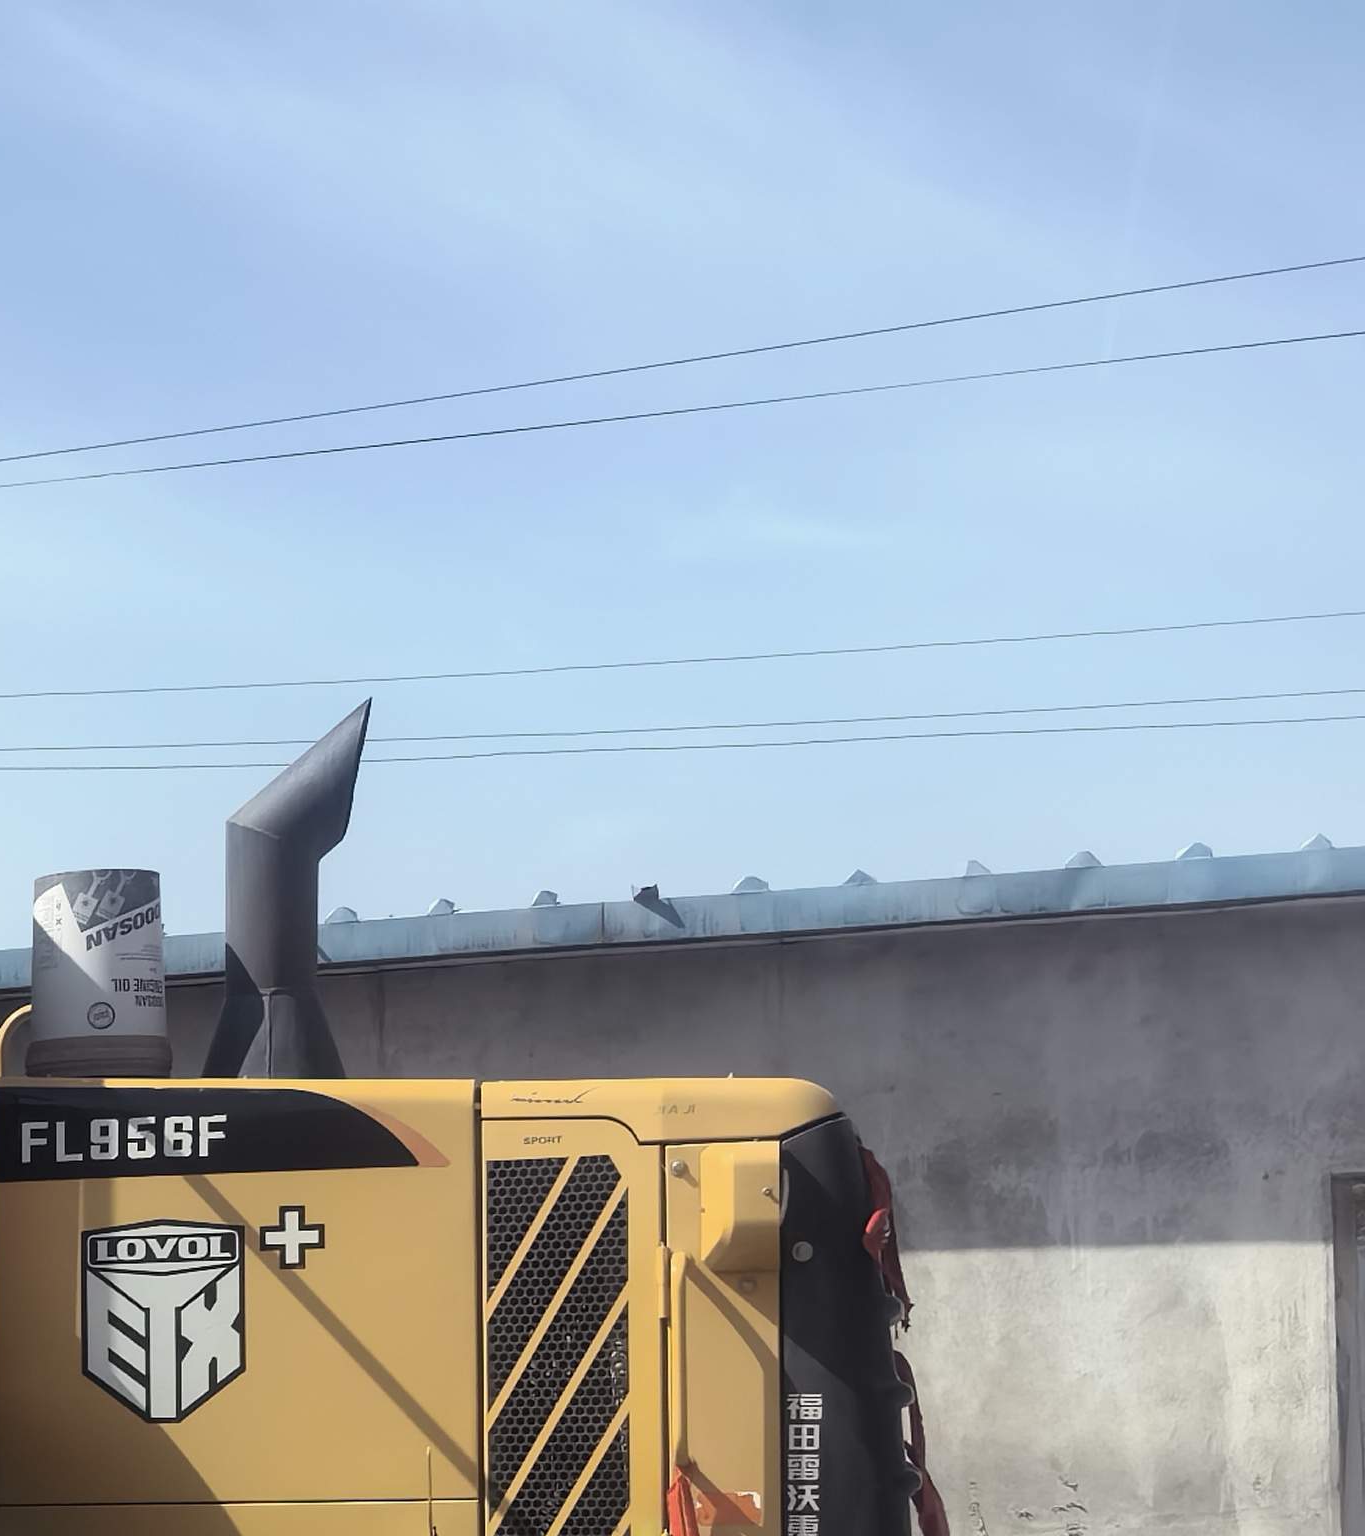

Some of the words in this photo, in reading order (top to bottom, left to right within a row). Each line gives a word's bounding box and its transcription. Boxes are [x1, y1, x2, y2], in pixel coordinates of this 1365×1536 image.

[111, 977, 131, 993] OIL
[21, 1114, 228, 1164] FL956F
[523, 1135, 563, 1145] SPORT
[95, 1235, 233, 1263] LOVOL
